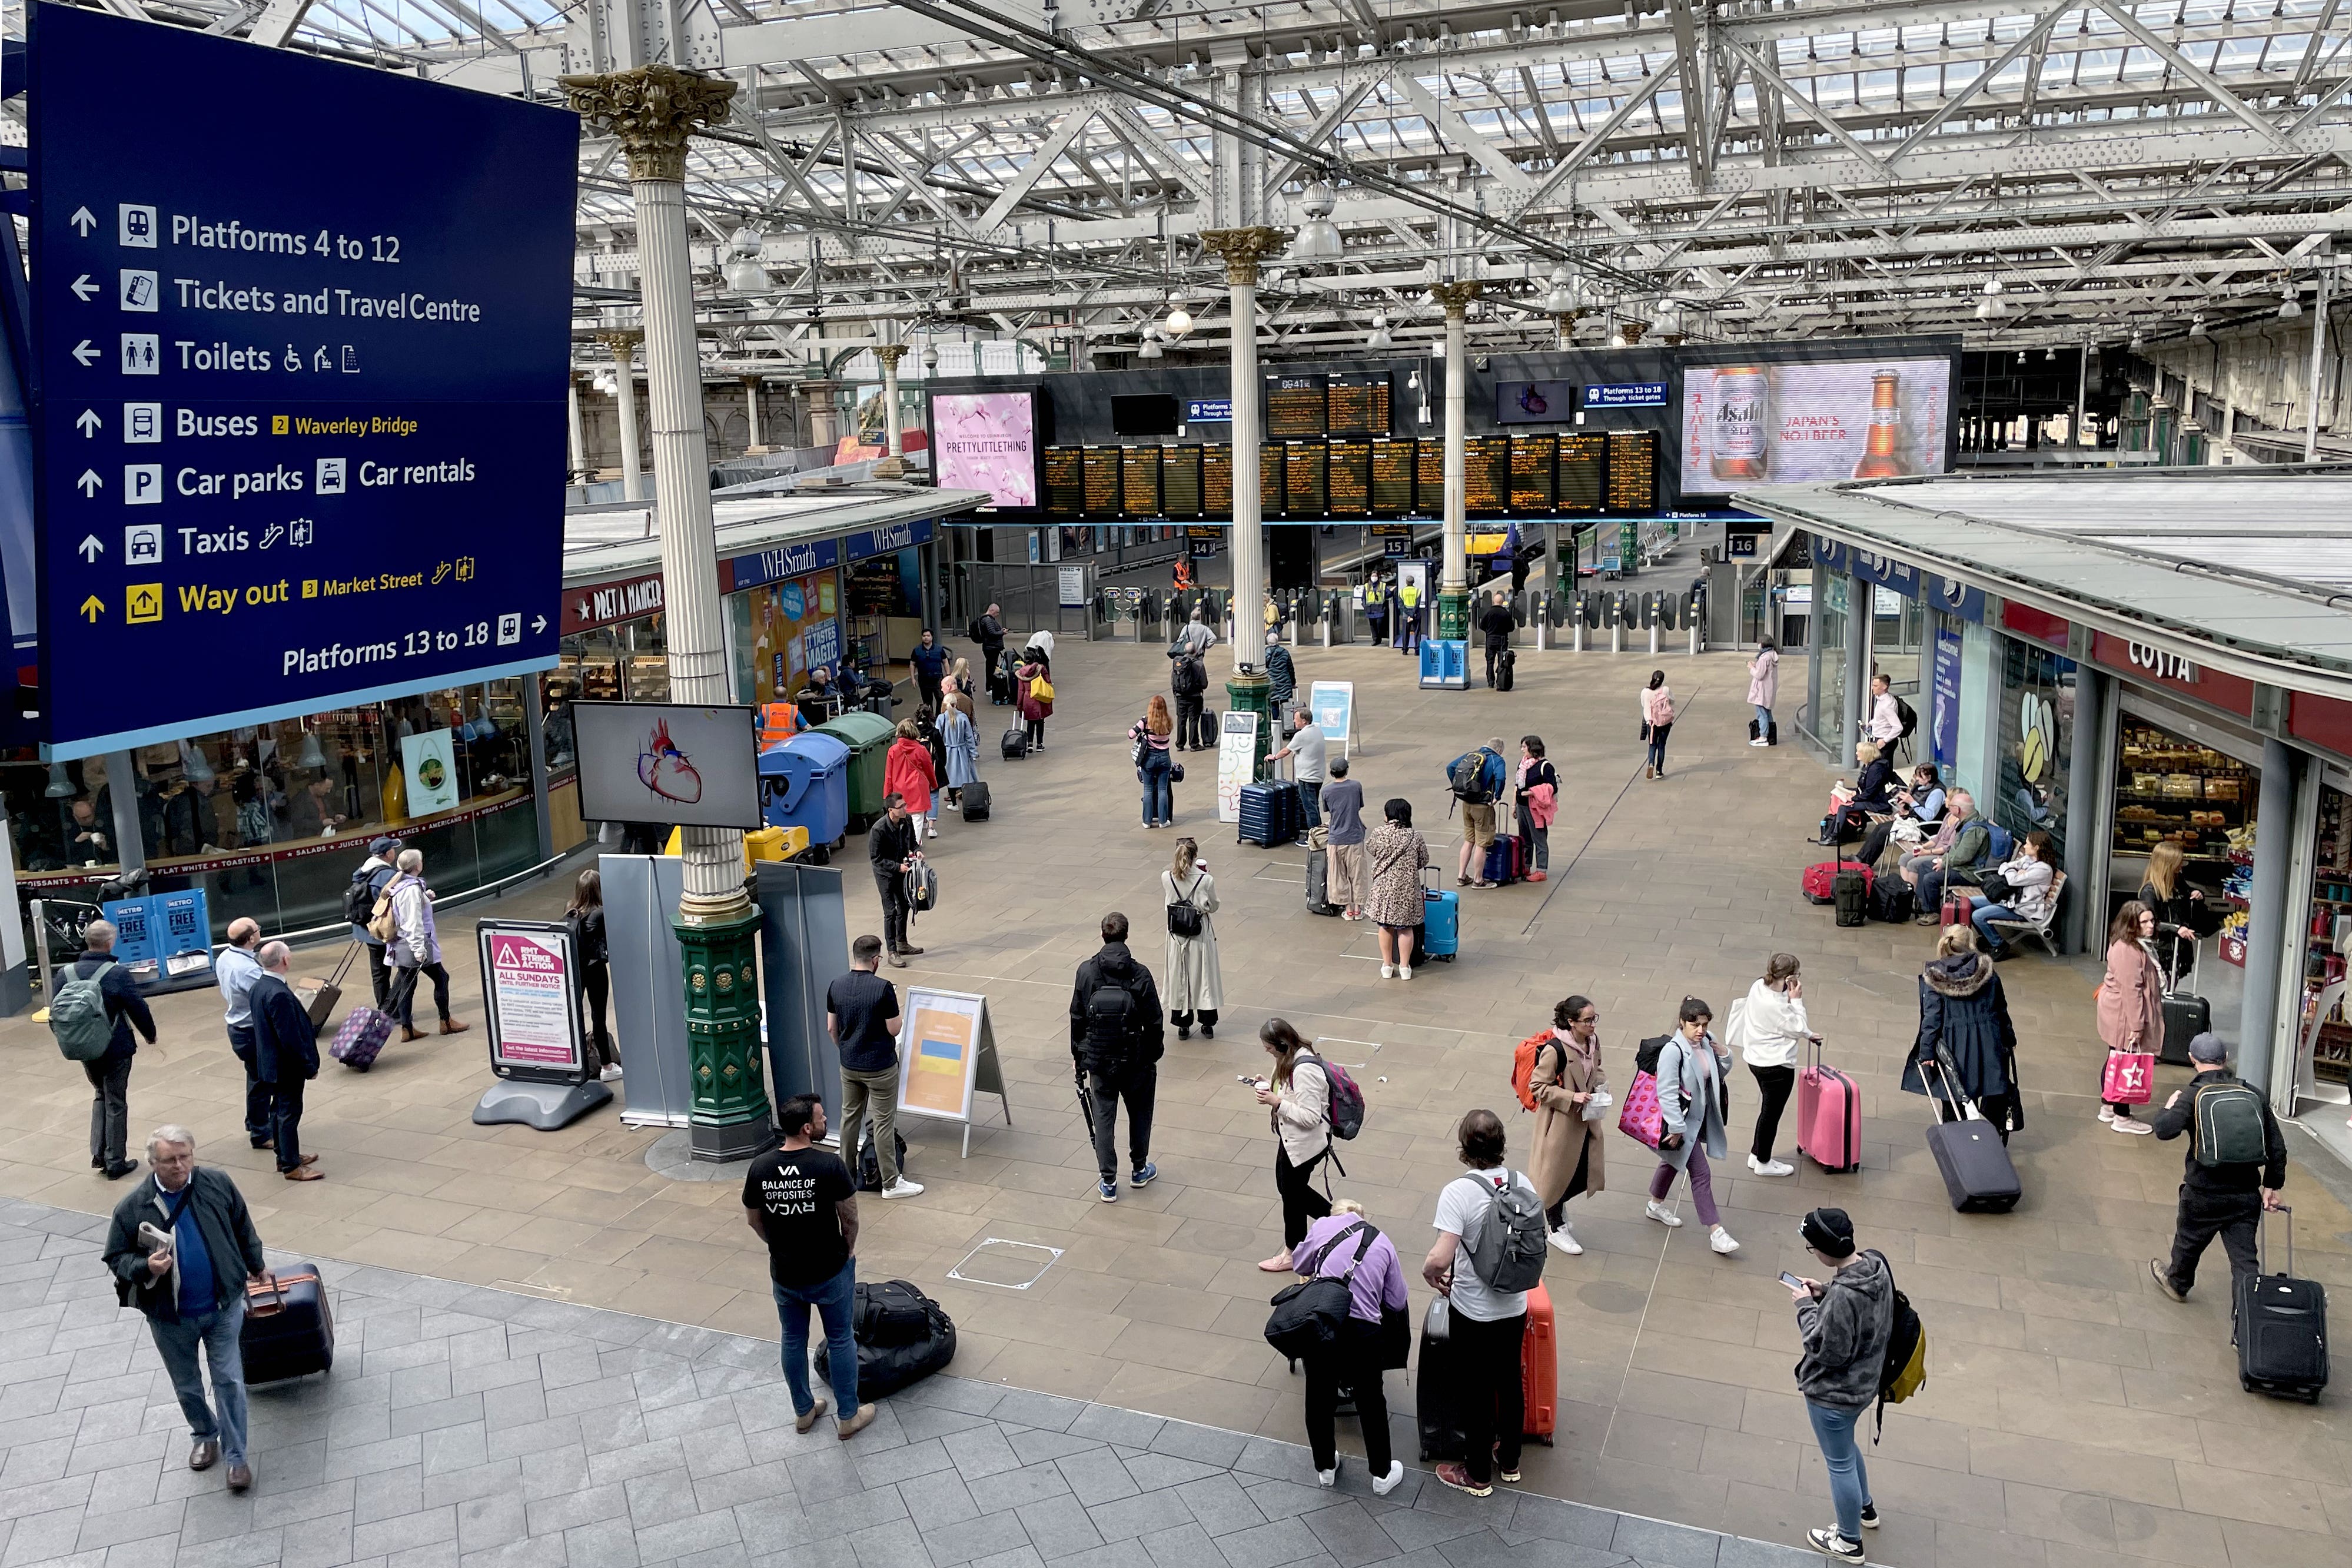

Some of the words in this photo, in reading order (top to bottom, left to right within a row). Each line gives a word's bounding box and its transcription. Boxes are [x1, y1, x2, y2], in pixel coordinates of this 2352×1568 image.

[172, 215, 307, 255] Platforms
[314, 230, 331, 257] 4
[338, 232, 364, 261] to
[371, 235, 400, 264] 12
[174, 278, 275, 313] Tickets
[283, 287, 328, 317] and
[335, 290, 406, 320] Travel
[410, 294, 480, 322] Centre
[175, 341, 271, 371] Toilets
[1717, 401, 1763, 421] Asahi
[177, 408, 258, 437] Buses
[277, 418, 284, 431] 2
[295, 417, 368, 437] Waverley
[372, 416, 417, 437] Bridge
[1813, 430, 1846, 440] BEER
[947, 441, 1026, 453] PRETTYLITTLETHING
[136, 471, 151, 496] P
[177, 467, 225, 497] Car
[234, 464, 303, 499] parks
[360, 461, 398, 486] Car
[404, 458, 475, 484] rentals
[178, 525, 249, 554] Taxis
[873, 523, 912, 552] WHSmith
[1388, 542, 1401, 552] 15
[1736, 540, 1752, 551] 16
[1194, 544, 1207, 553] 14
[1210, 543, 1215, 553] 14
[761, 543, 816, 580] WHSmith
[1895, 562, 1911, 582] beauty
[178, 584, 238, 614] Way
[247, 579, 289, 605] out
[307, 583, 313, 594] 3
[324, 576, 376, 597] Market
[380, 572, 423, 591] Street
[594, 589, 617, 621] PRET
[620, 587, 626, 615] A
[627, 579, 662, 614] MANGER
[805, 636, 812, 649] IT
[813, 626, 836, 647] TASTES
[283, 639, 397, 675] Platforms
[404, 633, 429, 656] 13
[437, 630, 458, 650] to
[465, 623, 488, 646] 18
[806, 641, 837, 670] MAGIC
[1938, 639, 1958, 657] welcome
[2129, 641, 2190, 682] COSTA
[481, 805, 498, 814] WRAPS
[504, 794, 529, 807] SANDWICHES
[398, 827, 419, 836] CAKES
[428, 815, 462, 829] AMERICANO
[296, 845, 326, 856] SALADS
[338, 838, 364, 848] JUICES
[158, 867, 179, 876] FLAT
[181, 863, 209, 873] WHITE
[222, 856, 261, 867] TOASTIES
[118, 906, 142, 915] METRO
[168, 899, 192, 907] METRO
[119, 920, 145, 934] FREE
[169, 913, 195, 926] FREE
[522, 962, 554, 970] ACTION
[499, 972, 515, 980] ALL
[517, 974, 559, 983] SUNDAYS
[778, 1165, 800, 1175] VA
[762, 1180, 802, 1190] BALANCE
[804, 1179, 815, 1188] OF
[765, 1202, 815, 1215] RVCA
